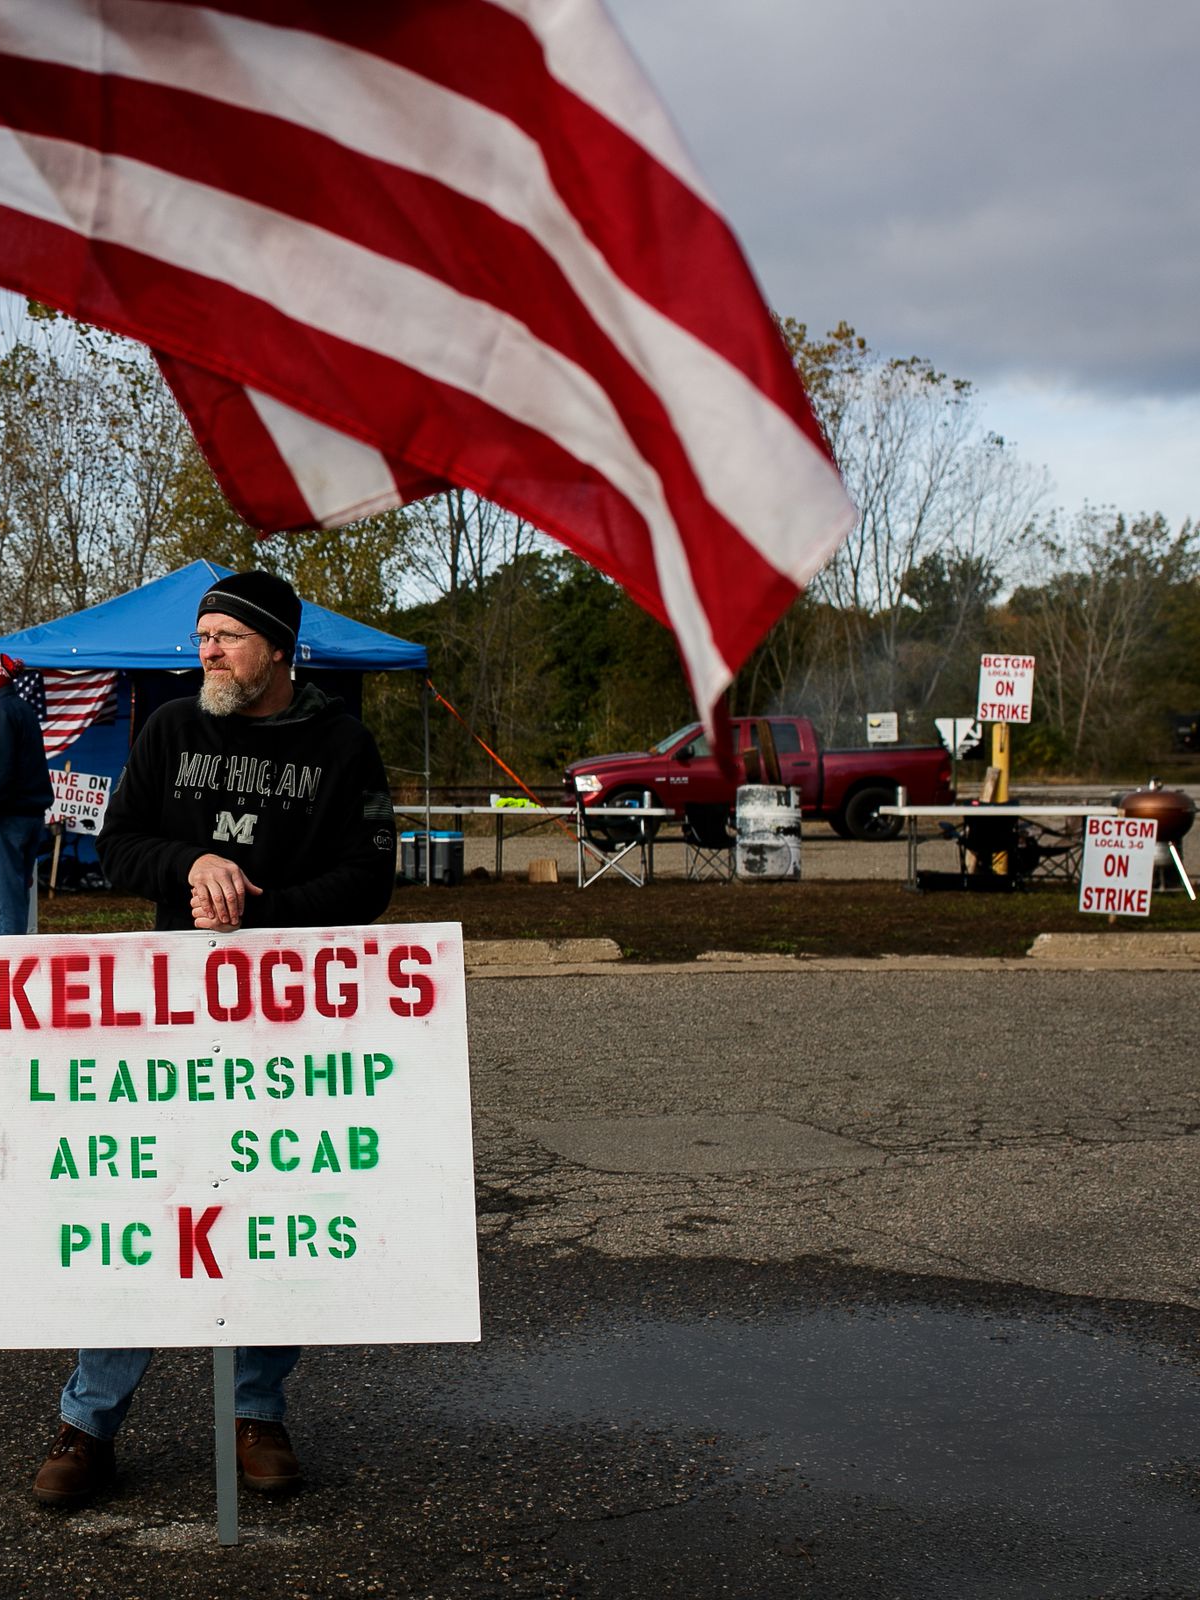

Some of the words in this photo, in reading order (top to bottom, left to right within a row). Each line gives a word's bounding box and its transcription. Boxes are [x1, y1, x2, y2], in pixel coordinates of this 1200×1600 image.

[983, 657, 1033, 669] BCTGM
[995, 680, 1014, 696] ON
[980, 703, 1029, 720] STRIKE
[89, 776, 109, 791] ON
[175, 751, 322, 801] MICHIGAN
[55, 788, 105, 805] LOGGS
[174, 791, 202, 800] GO
[237, 796, 314, 815] BLUE
[60, 802, 99, 817] USING
[212, 810, 258, 845] M
[1088, 819, 1154, 838] BCTGM
[1095, 839, 1125, 849] LOCAL
[1104, 854, 1129, 878] ON
[1083, 886, 1148, 913] STRIKE
[30, 1052, 395, 1103] LEADERSHIP
[50, 1135, 158, 1179] ARE
[230, 1127, 380, 1173] SCAB
